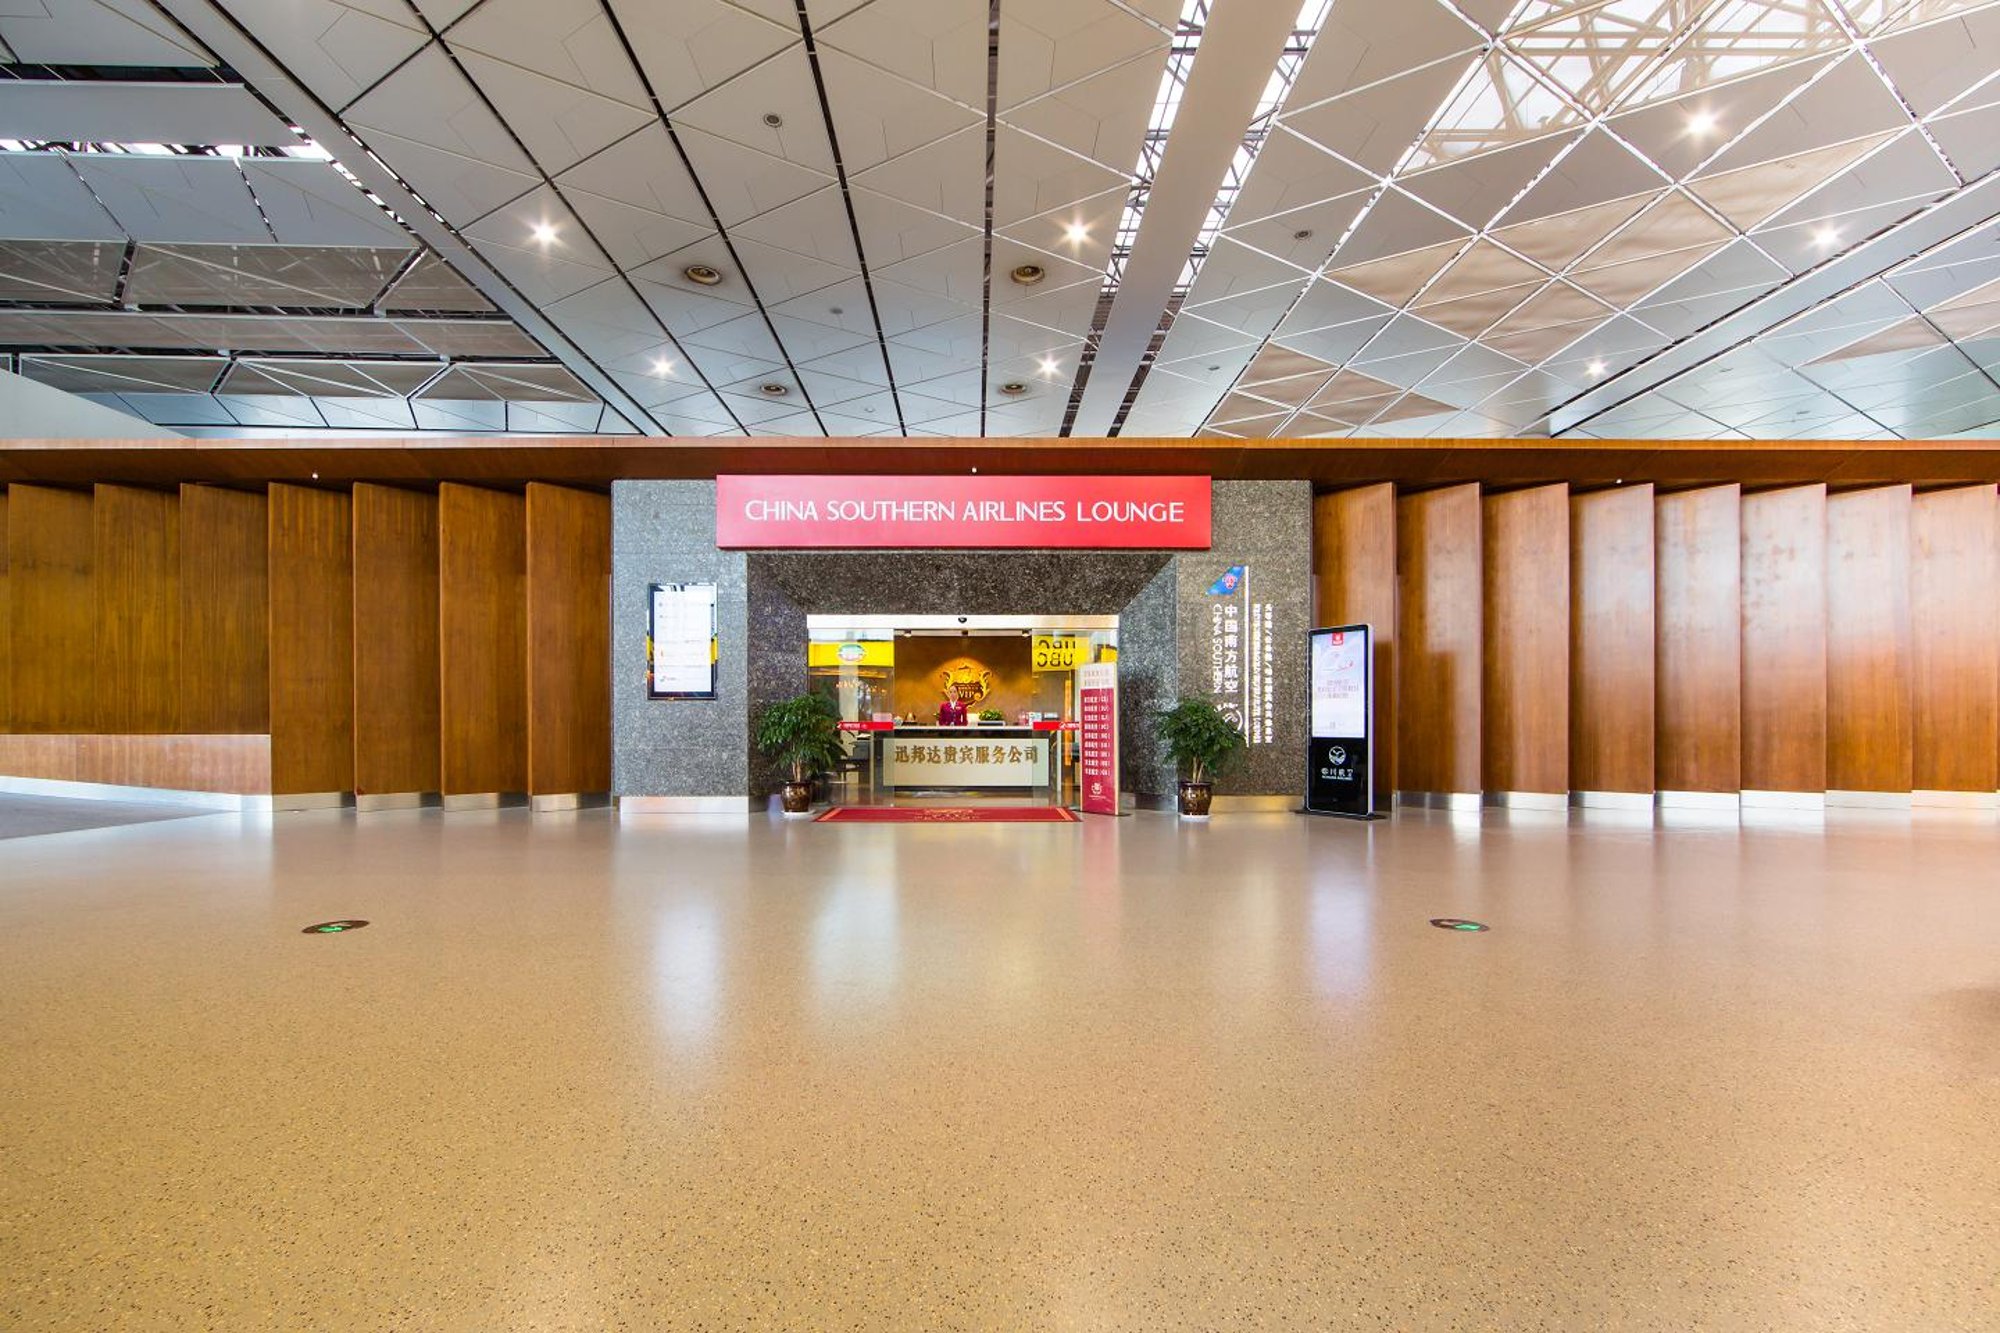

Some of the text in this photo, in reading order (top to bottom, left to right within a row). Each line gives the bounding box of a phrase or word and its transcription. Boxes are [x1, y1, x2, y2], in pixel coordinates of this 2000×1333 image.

[744, 500, 1185, 523] CHINA SOUTHERN AIRLINES LOUNGE
[1212, 603, 1223, 694] CHINA SOUTHERN
[1224, 604, 1238, 694] 中国南方航空
